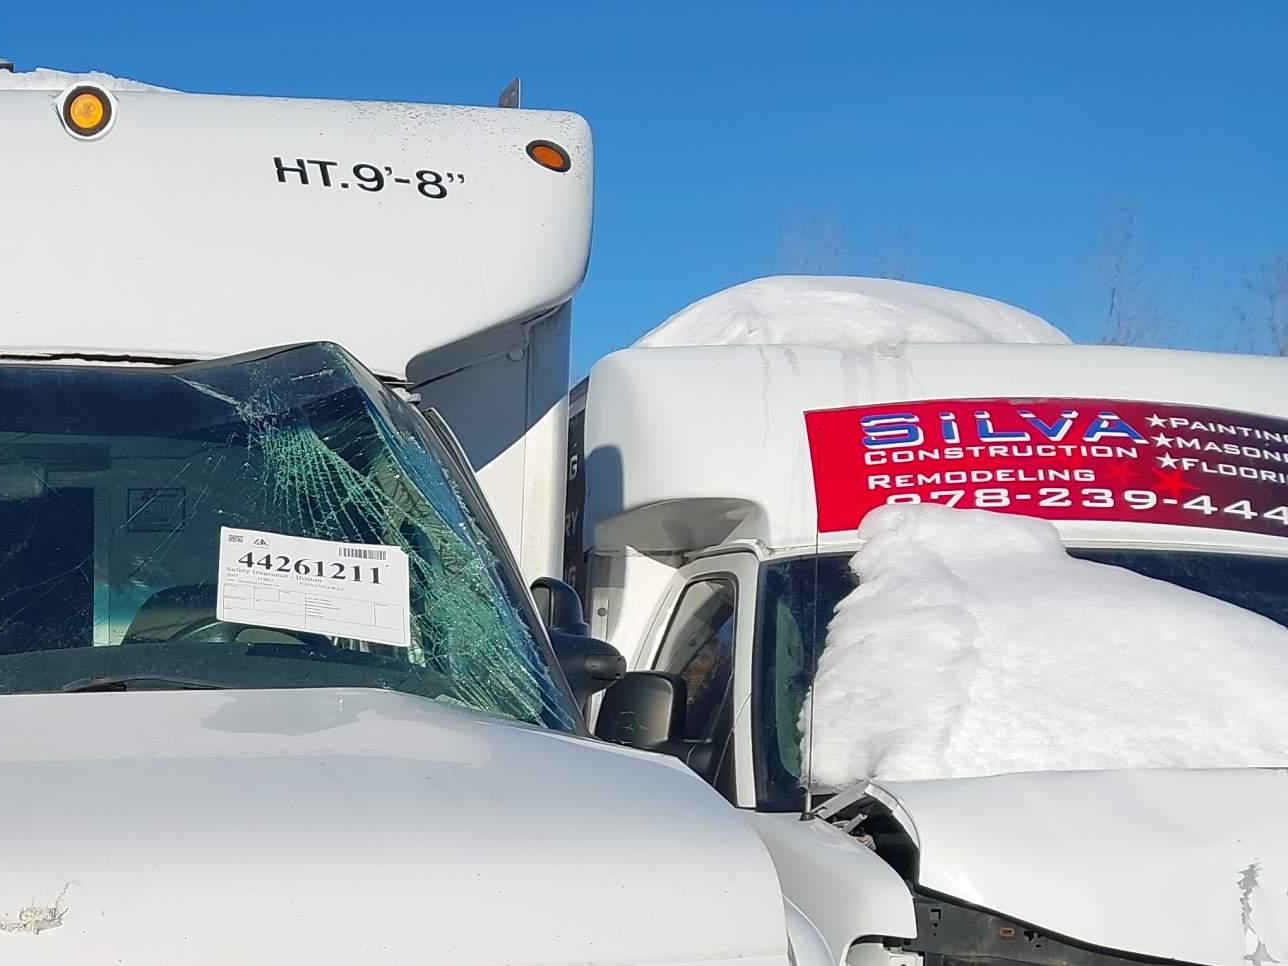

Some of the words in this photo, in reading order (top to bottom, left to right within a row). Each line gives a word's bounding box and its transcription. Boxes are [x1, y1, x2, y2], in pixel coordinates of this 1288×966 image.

[860, 410, 1150, 450] SILVA
[864, 445, 1138, 466] CONSTRUCTION
[867, 468, 1096, 490] REMODELING
[1181, 458, 1288, 485] FLOORI
[238, 551, 382, 585] 44261211
